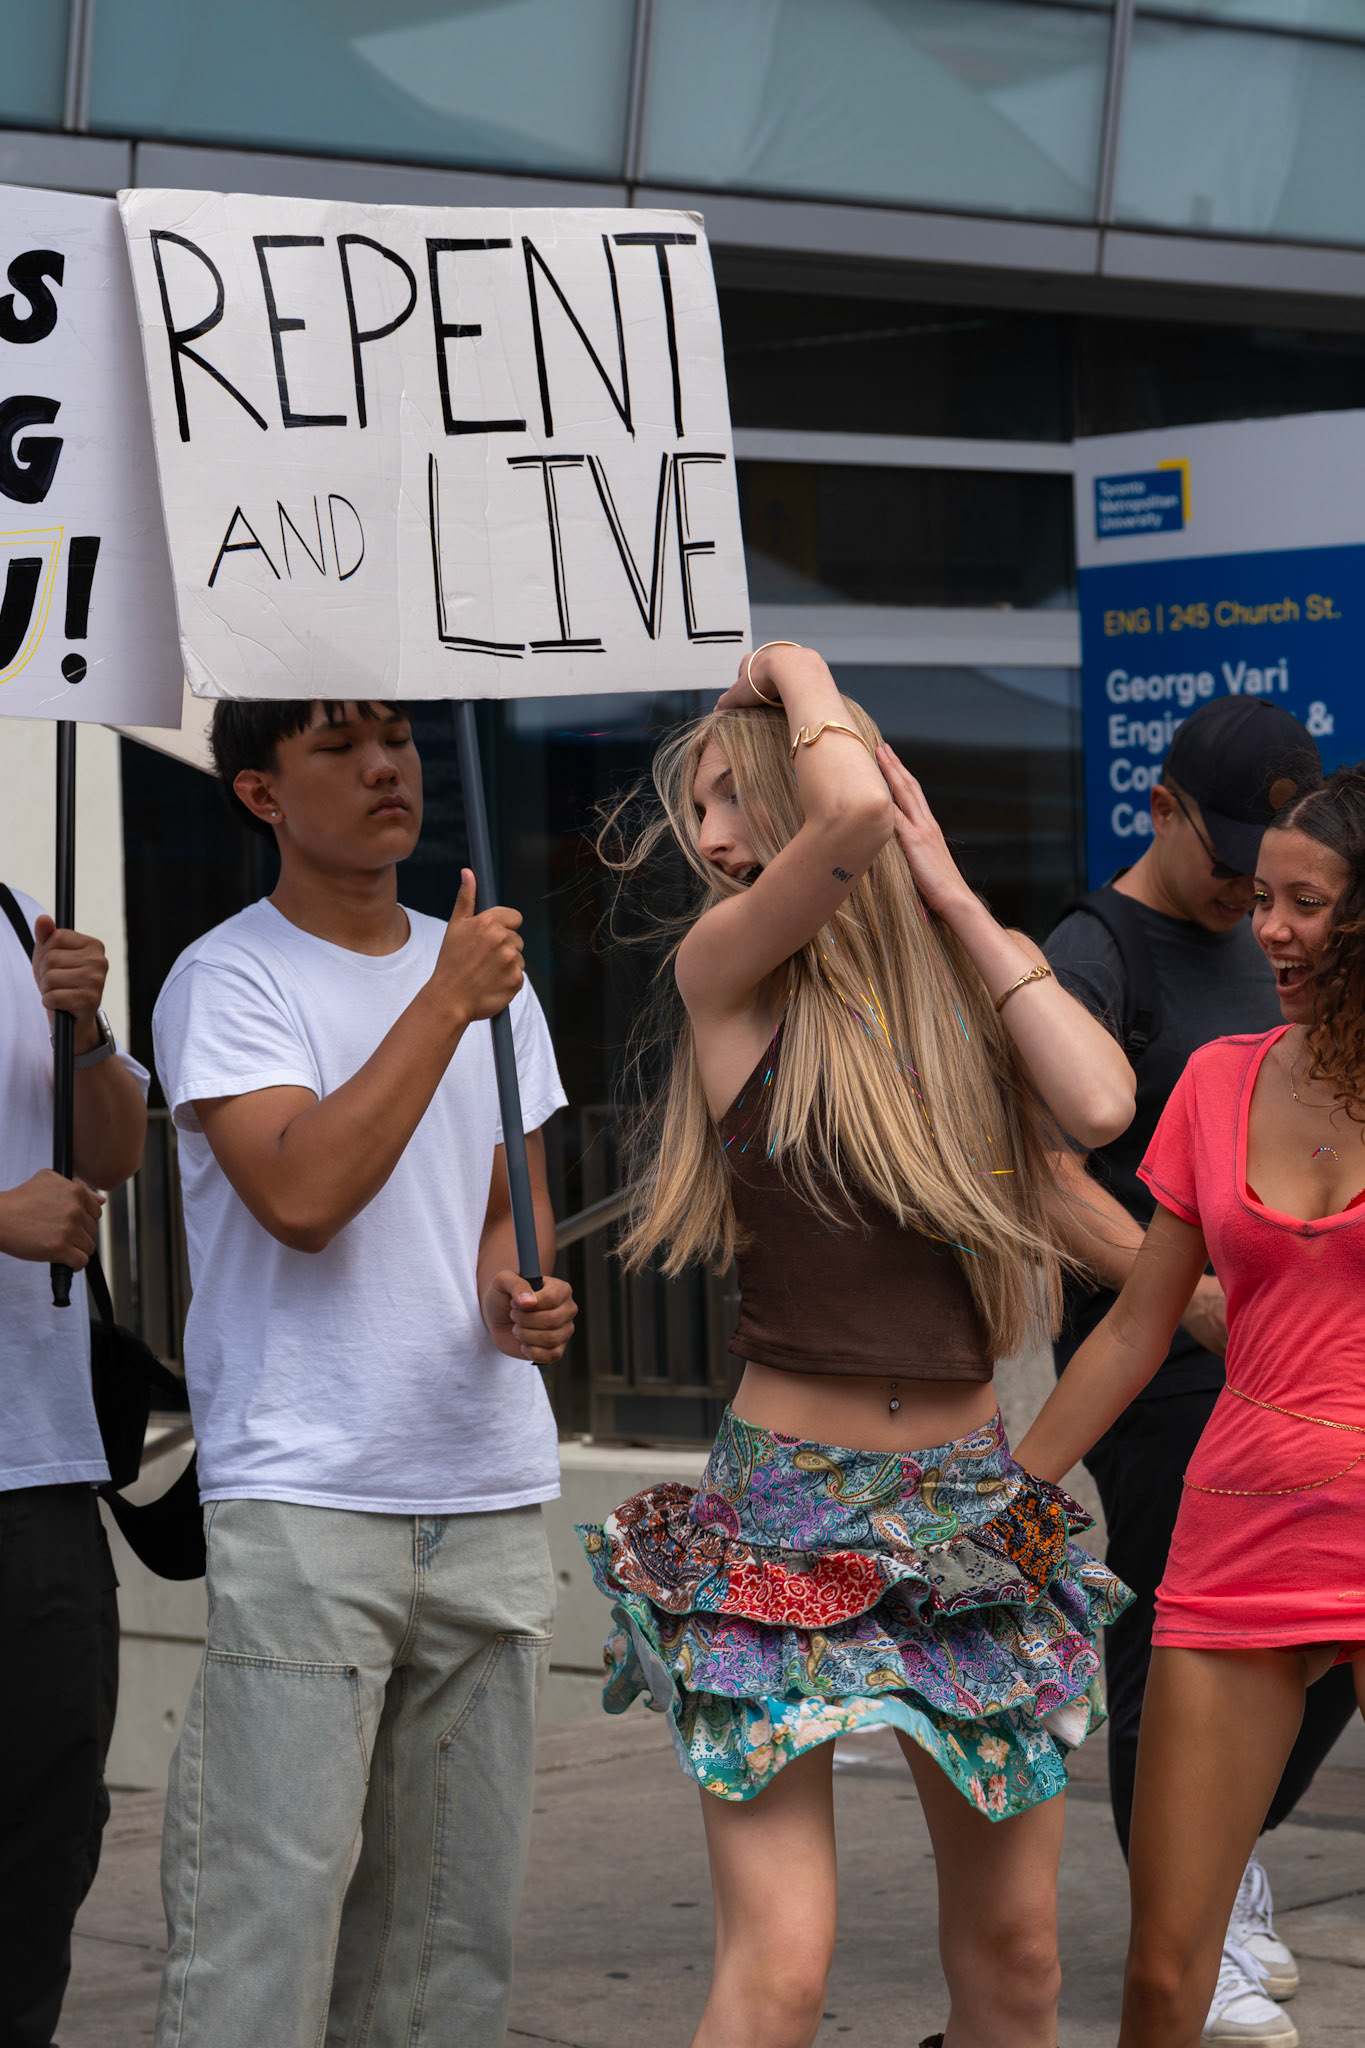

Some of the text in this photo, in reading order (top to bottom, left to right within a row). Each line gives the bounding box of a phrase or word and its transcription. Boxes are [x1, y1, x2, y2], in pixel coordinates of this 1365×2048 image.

[149, 228, 697, 443] REPENT
[1099, 481, 1146, 499] Toronto
[1099, 494, 1179, 514] Metropolitan
[1100, 512, 1163, 532] University
[207, 452, 744, 659] AND LIVE
[1104, 607, 1151, 637] ENG
[1168, 602, 1211, 631] 245
[1214, 597, 1300, 628] Church
[1305, 593, 1342, 622] St.
[1106, 657, 1289, 708] George Vari
[1306, 701, 1335, 737] &
